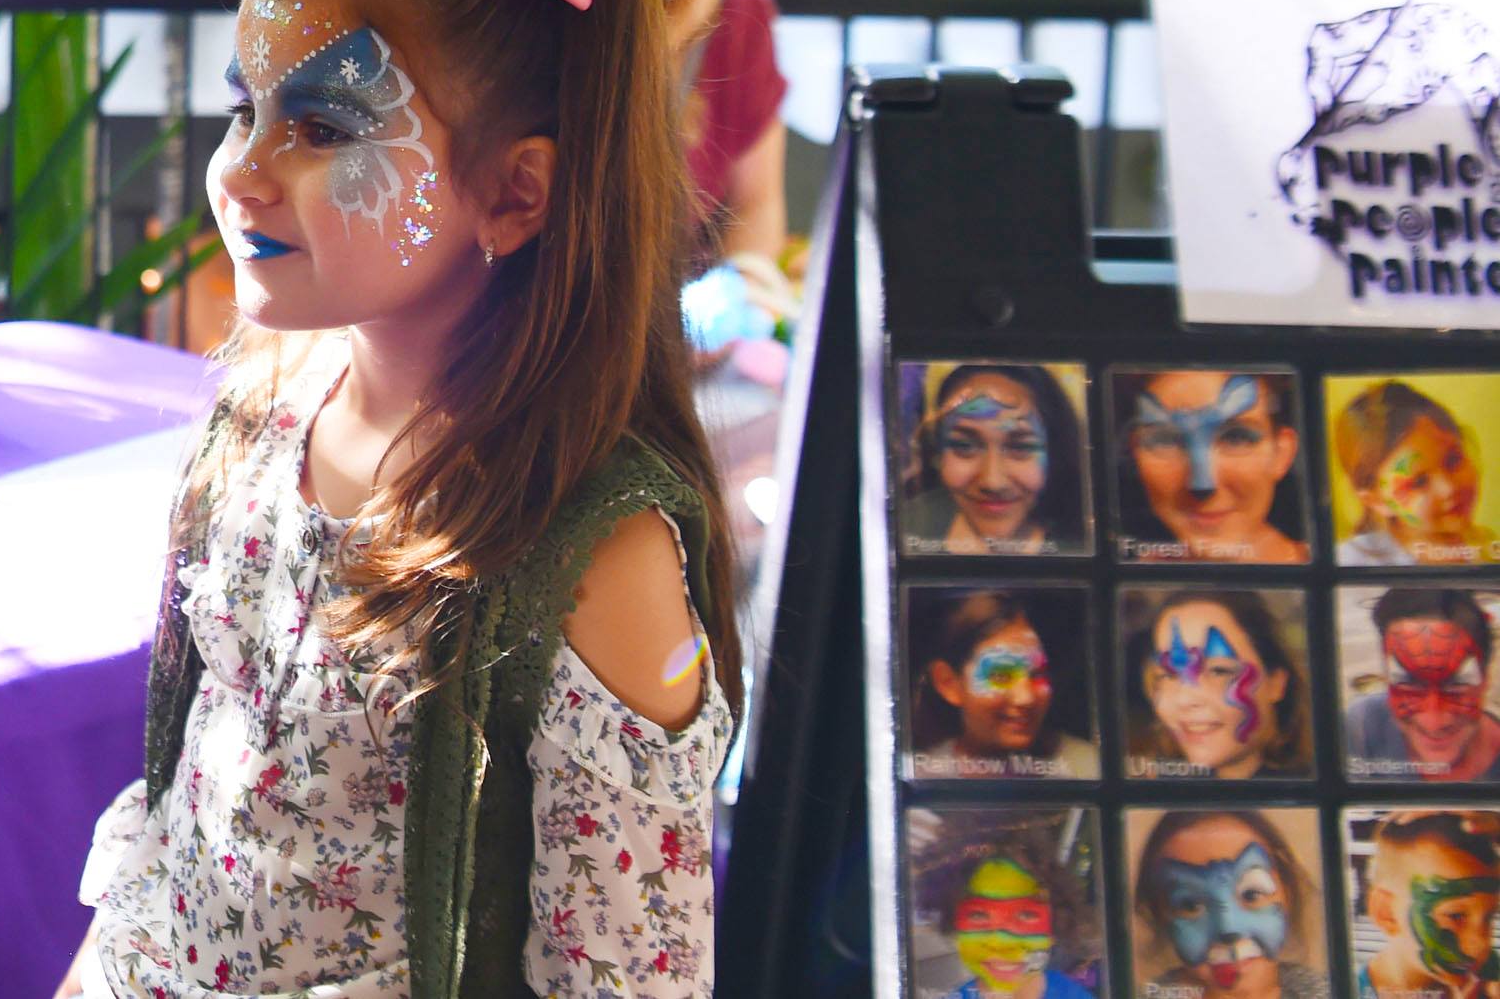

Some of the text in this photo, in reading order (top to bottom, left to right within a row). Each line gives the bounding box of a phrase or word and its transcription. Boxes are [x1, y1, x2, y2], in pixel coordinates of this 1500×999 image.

[1121, 537, 1189, 558] Forest
[914, 753, 1071, 775] Rainbow Mask
[1126, 754, 1211, 778] Unicorn
[1348, 755, 1452, 779] Spiderman
